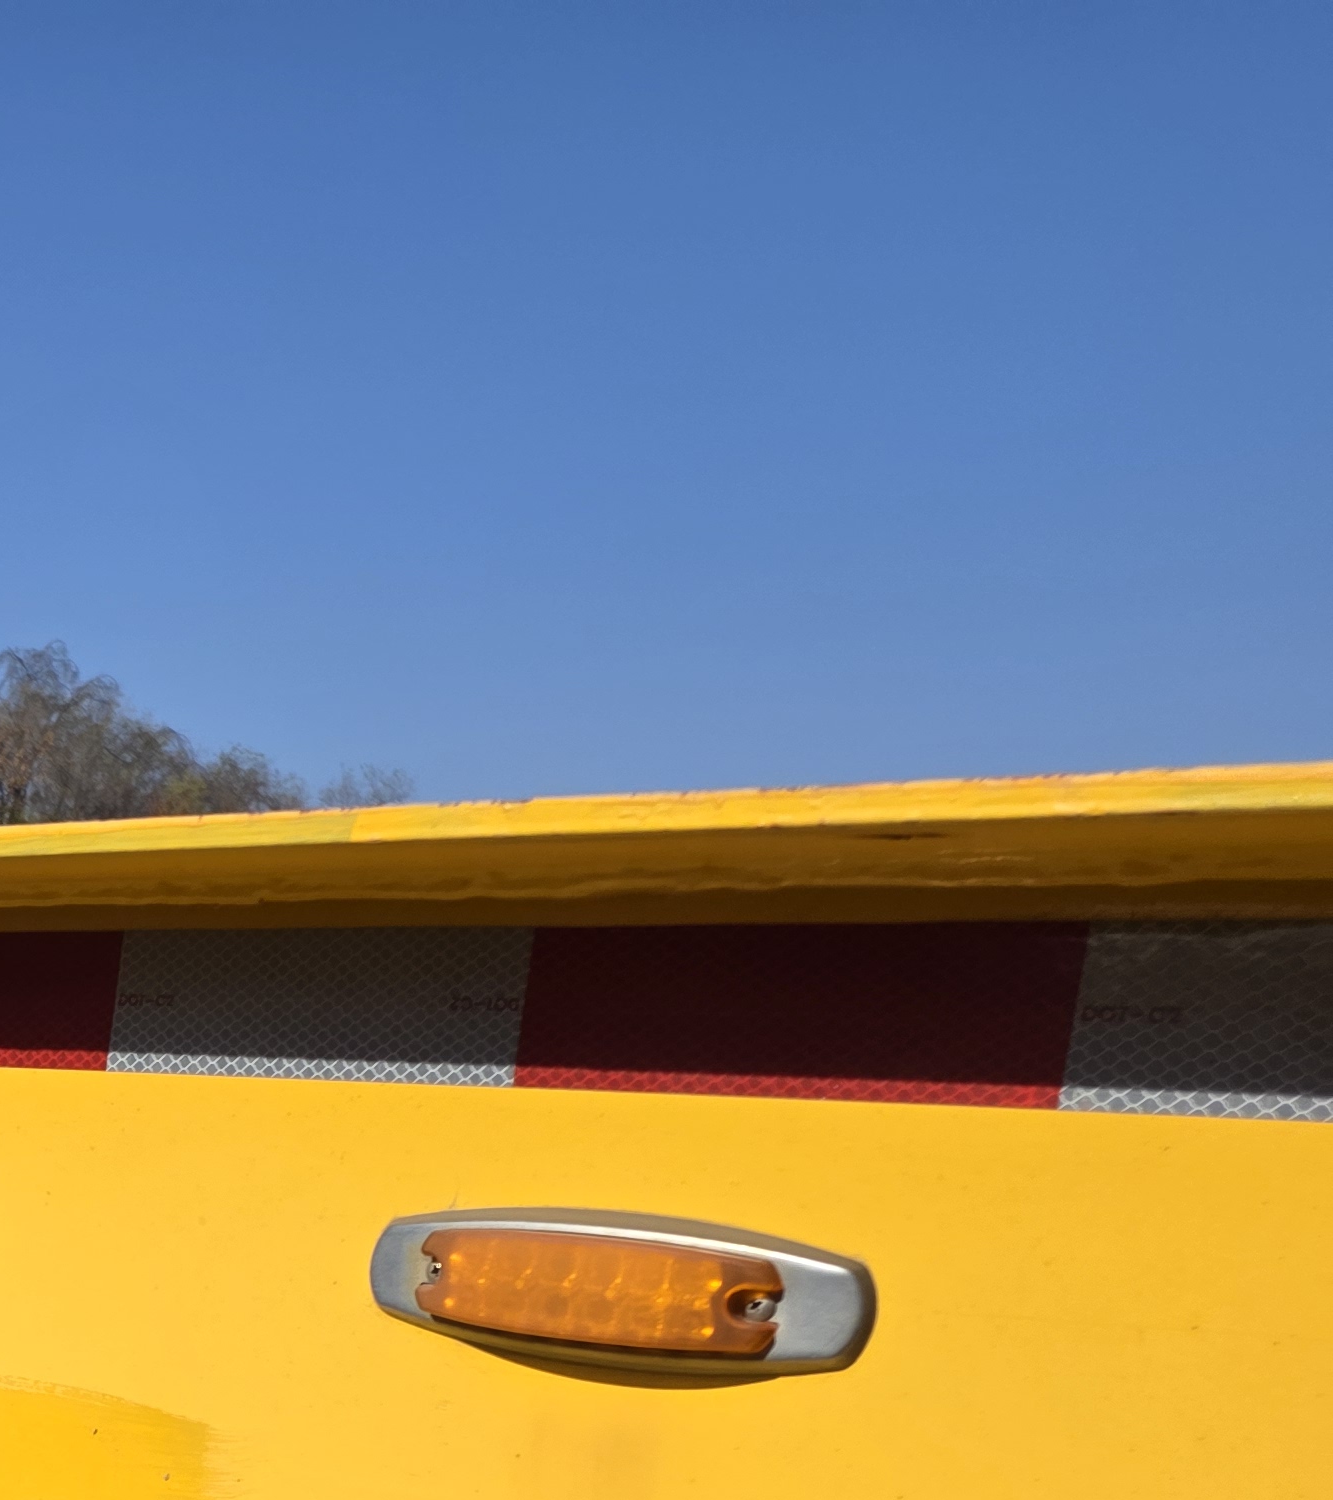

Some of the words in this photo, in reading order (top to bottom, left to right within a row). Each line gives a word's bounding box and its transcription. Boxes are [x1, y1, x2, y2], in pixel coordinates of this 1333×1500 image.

[117, 993, 175, 1007] DOT-C2
[449, 996, 519, 1012] DOT-C2
[1080, 1004, 1182, 1025] DOT-C2
